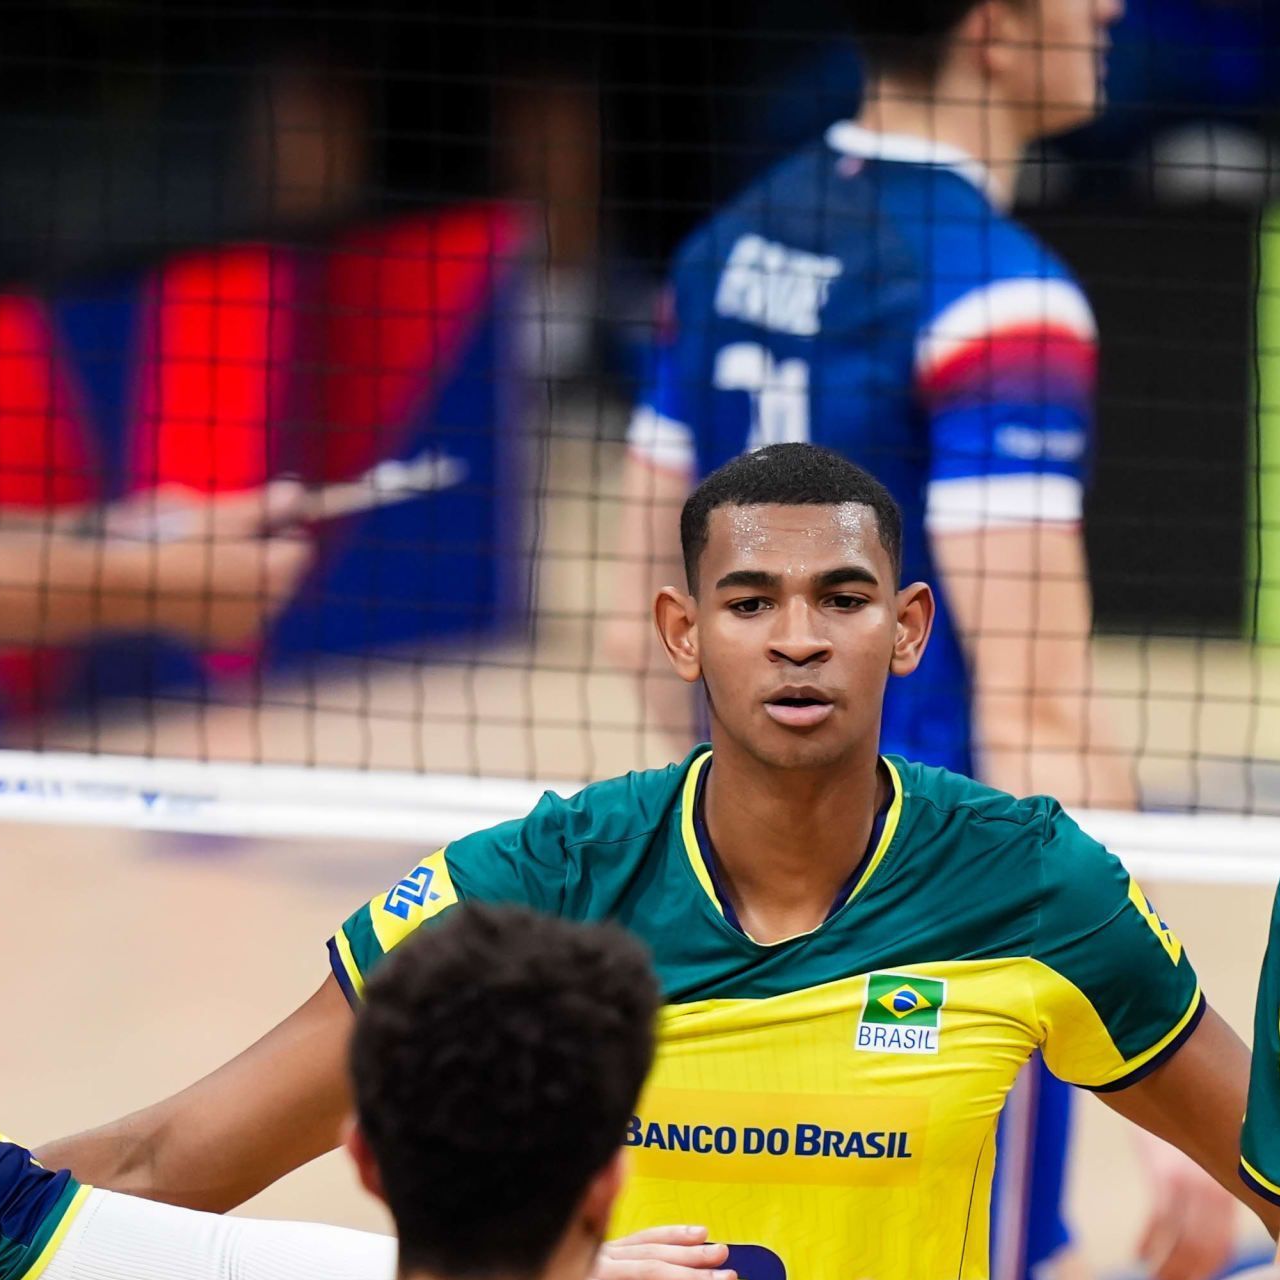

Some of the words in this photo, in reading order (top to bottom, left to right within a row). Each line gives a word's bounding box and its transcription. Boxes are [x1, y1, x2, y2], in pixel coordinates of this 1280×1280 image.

[858, 1026, 935, 1050] BRASIL
[623, 1115, 736, 1155] BANCO
[742, 1127, 789, 1156] DO
[794, 1123, 912, 1159] BRASIL
